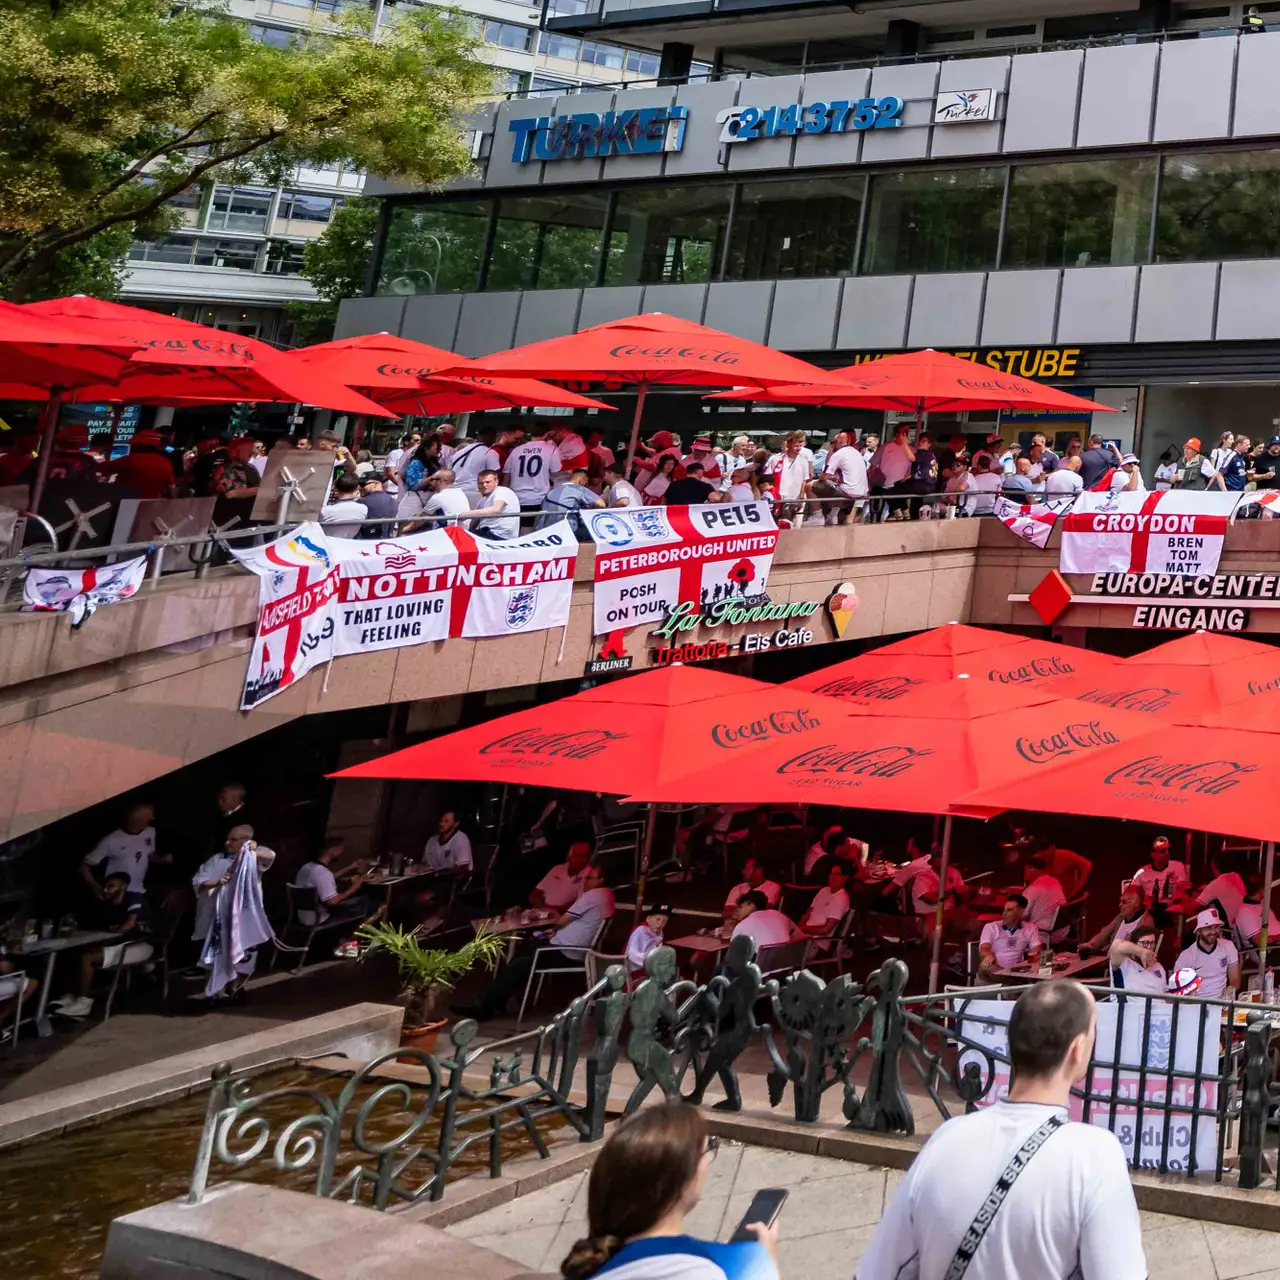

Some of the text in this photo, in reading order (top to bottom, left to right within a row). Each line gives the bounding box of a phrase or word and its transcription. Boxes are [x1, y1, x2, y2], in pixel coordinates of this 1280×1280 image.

[518, 454, 543, 478] 10
[701, 503, 762, 530] PE15
[1092, 514, 1196, 533] CROYDON
[599, 534, 776, 575] PETERBOROUGH UNITED
[1167, 537, 1204, 549] BREN
[1170, 550, 1199, 561] TOM
[345, 558, 569, 602] NOTTINGHAM
[1165, 562, 1202, 574] MATT
[619, 582, 657, 601] POSH
[344, 598, 445, 626] THAT LOVING
[606, 600, 668, 623] ON TOUR
[652, 597, 820, 639] La Fontana
[1132, 606, 1245, 631] EINGANG
[360, 623, 422, 645] FEELING
[655, 640, 728, 666] Trattoria
[744, 634, 771, 654] Eis
[775, 626, 814, 647] Cafe
[591, 658, 630, 672] BERLINER
[1002, 1117, 1057, 1183] SEASIDE
[960, 1182, 1006, 1253] SEASIDE
